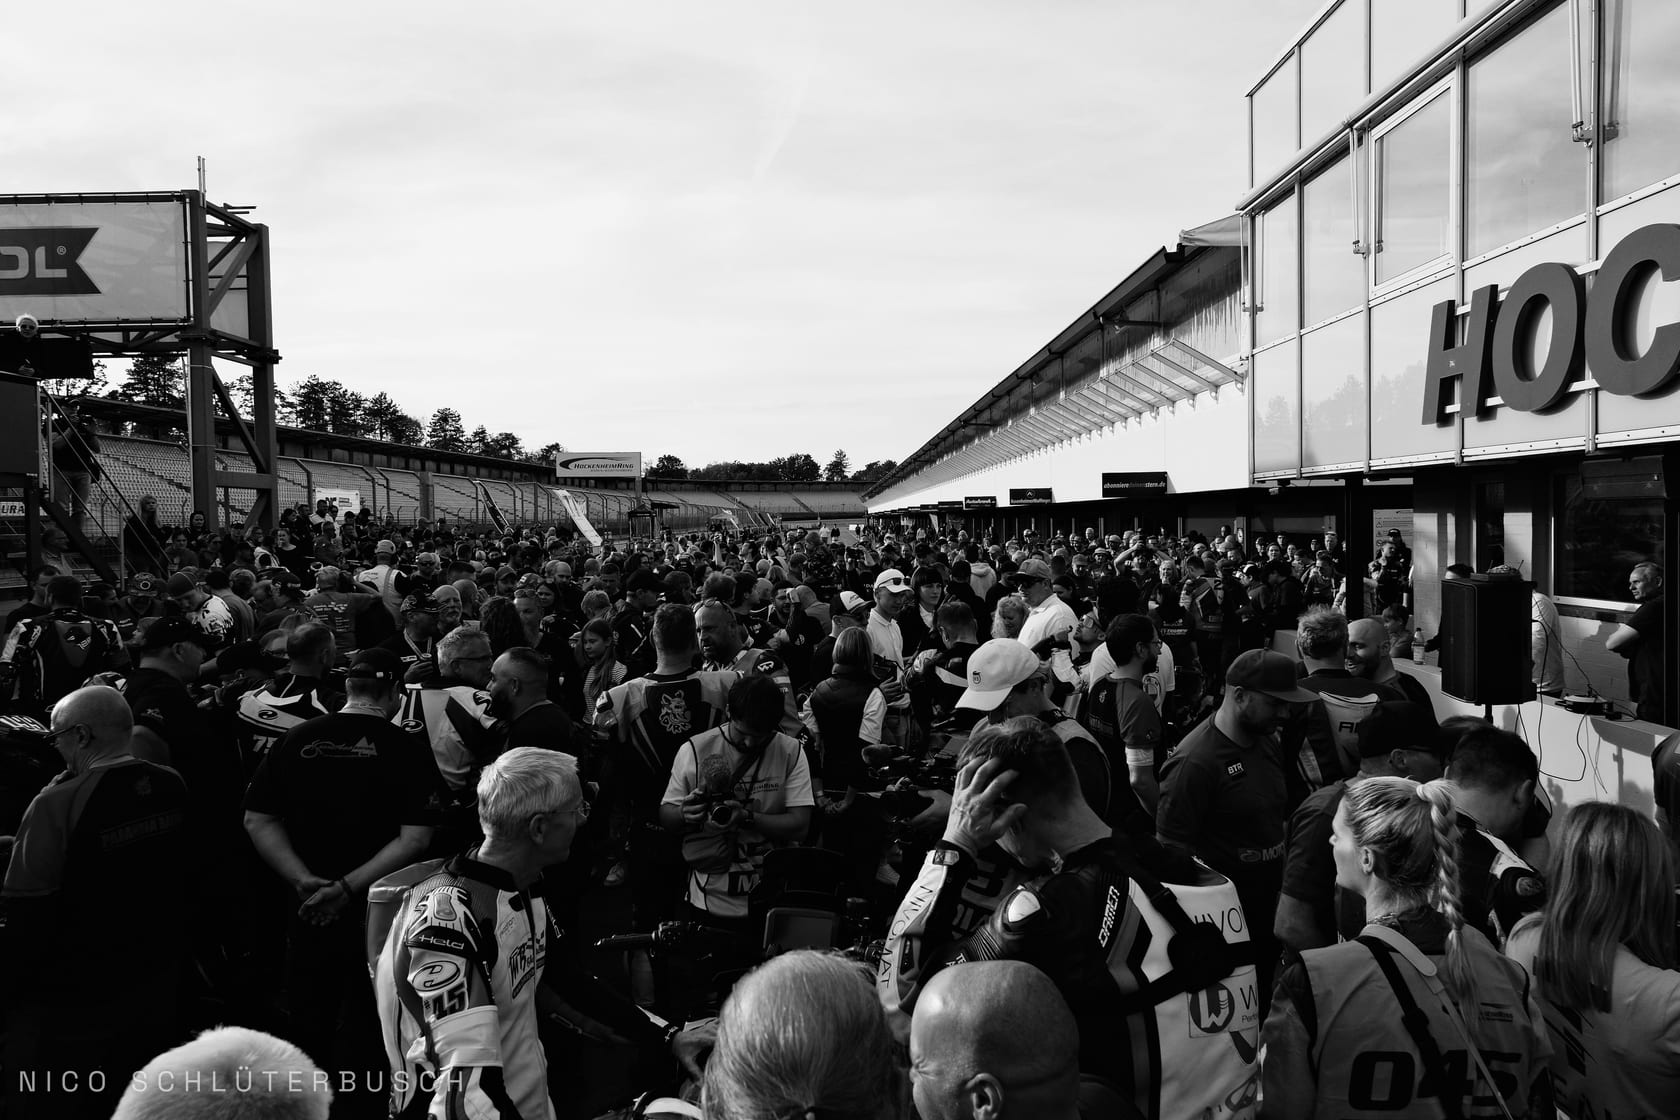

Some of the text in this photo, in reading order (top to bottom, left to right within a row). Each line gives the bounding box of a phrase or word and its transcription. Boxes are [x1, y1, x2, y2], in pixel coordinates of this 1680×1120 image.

[1422, 222, 1680, 425] HOC
[1227, 762, 1244, 775] BTR
[419, 934, 465, 950] Held
